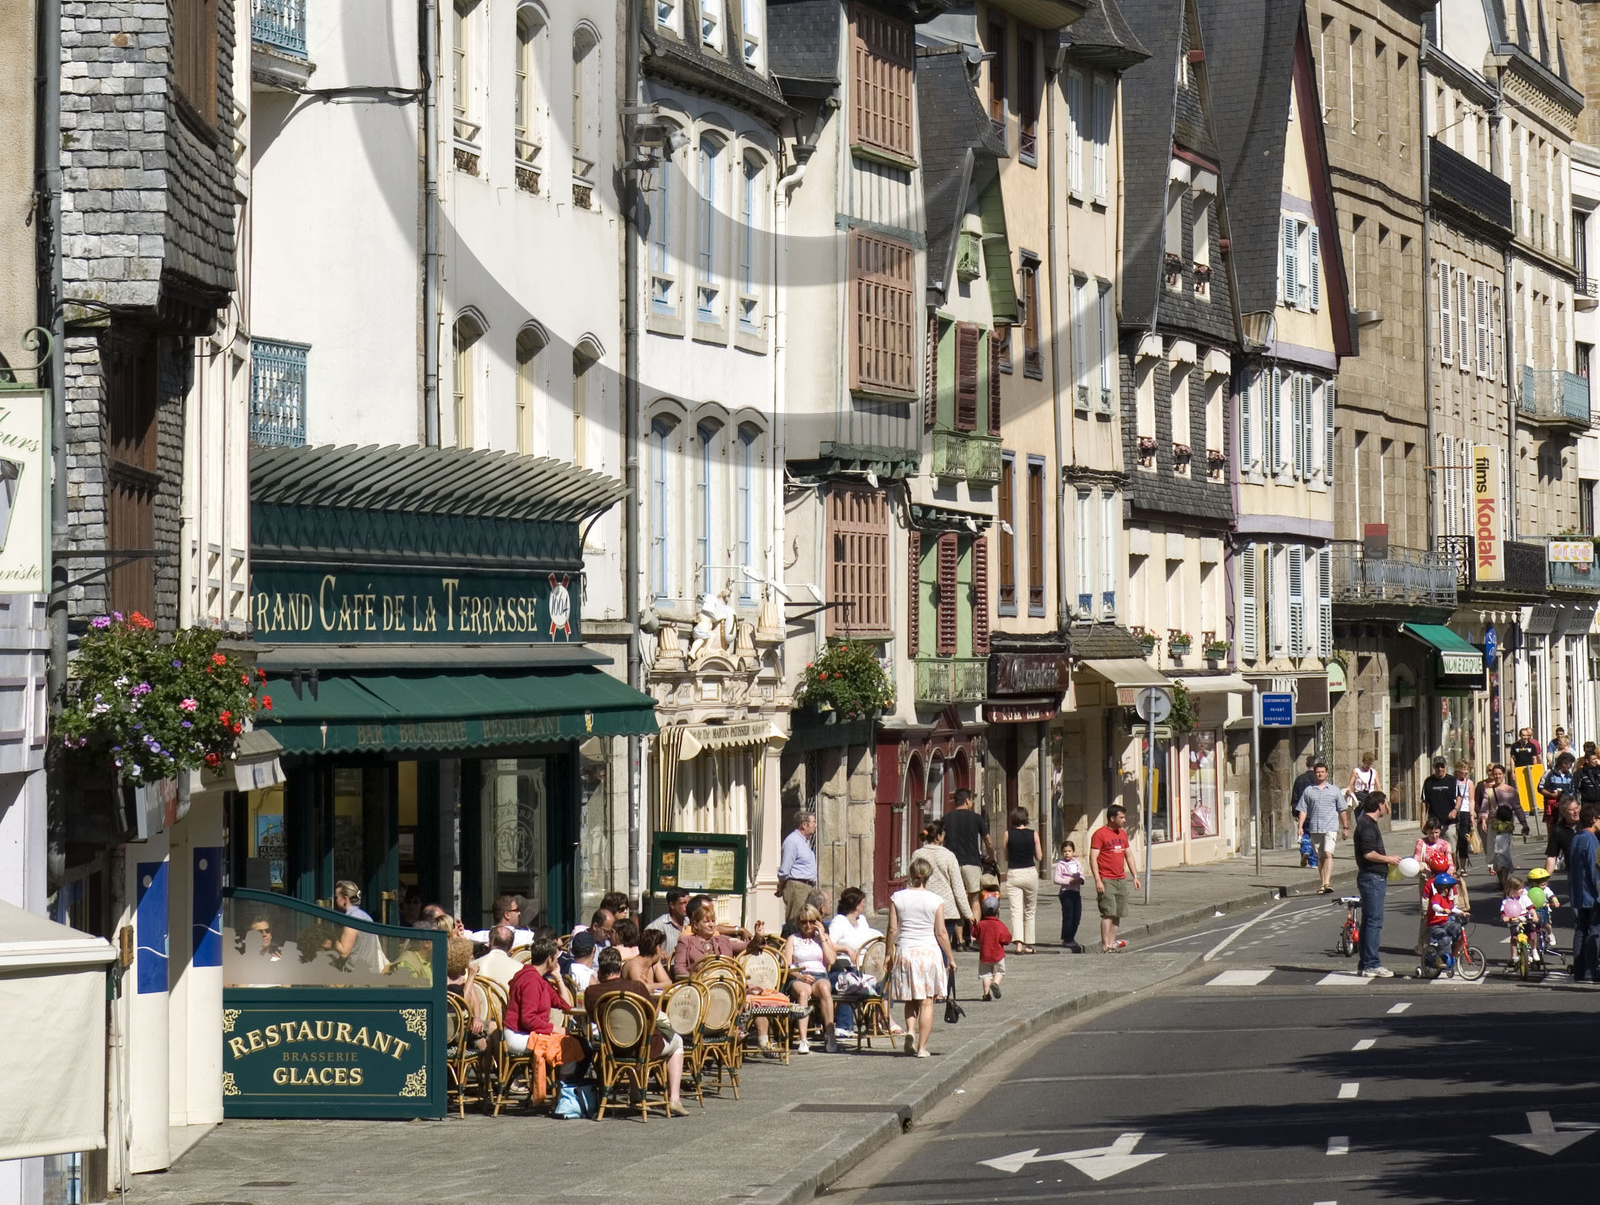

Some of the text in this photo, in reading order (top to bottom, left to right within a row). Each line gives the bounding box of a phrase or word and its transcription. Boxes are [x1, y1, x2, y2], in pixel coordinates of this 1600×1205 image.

[1475, 456, 1497, 569] films Kodak
[250, 574, 313, 634] RAND
[383, 595, 406, 631] DE
[413, 595, 437, 632] LA
[551, 591, 568, 617] 1664
[357, 715, 561, 744] BAR BRASSERIE RESTAURANT
[713, 727, 729, 739] MARTIN
[227, 1019, 411, 1060] RESTAURANT
[282, 1051, 359, 1062] BRASSERIE
[272, 1066, 364, 1086] GLACES
